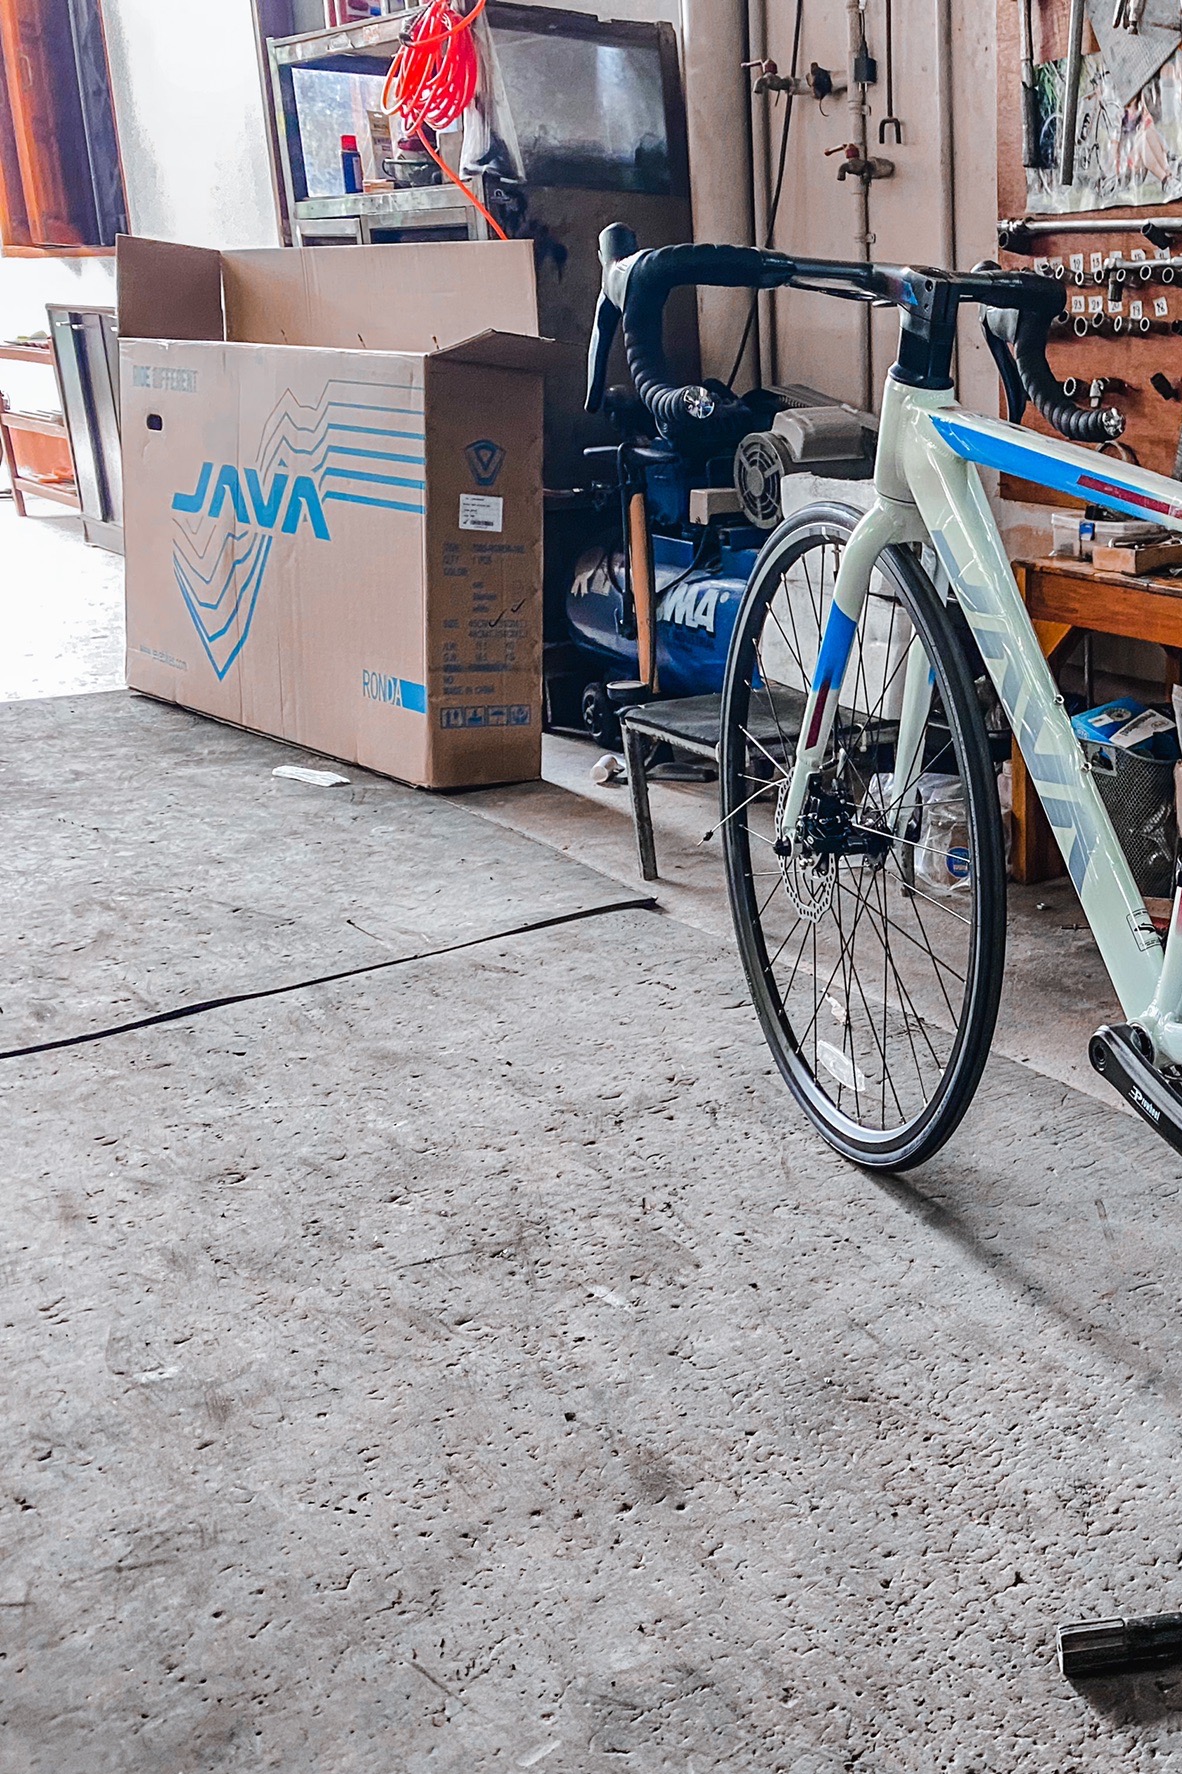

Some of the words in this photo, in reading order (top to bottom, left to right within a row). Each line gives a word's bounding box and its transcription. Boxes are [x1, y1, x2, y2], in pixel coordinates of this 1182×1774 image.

[152, 366, 199, 393] DIFFERENT
[171, 461, 331, 541] JAVA
[362, 668, 403, 708] RONDA
[931, 529, 1098, 896] JAVA
